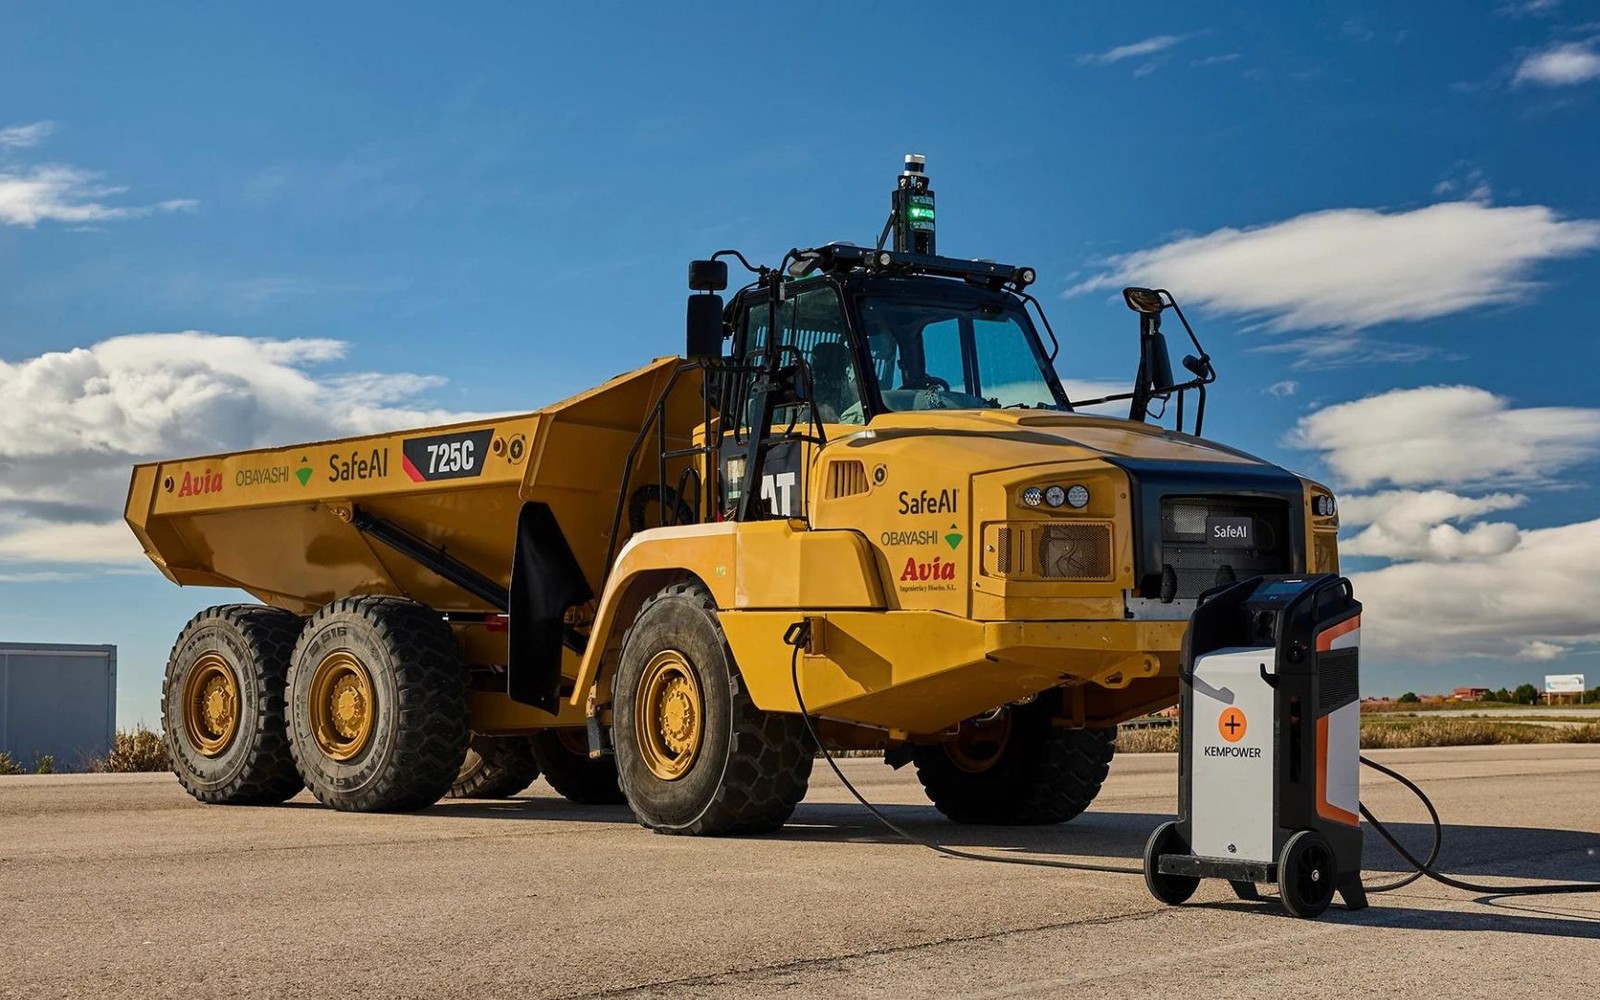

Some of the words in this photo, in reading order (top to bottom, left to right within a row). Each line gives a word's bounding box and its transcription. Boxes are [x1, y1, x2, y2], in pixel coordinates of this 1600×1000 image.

[328, 447, 388, 483] SafeAI
[427, 439, 475, 474] 725C
[178, 468, 223, 498] Avia
[235, 465, 290, 487] OBAYASHI
[761, 471, 796, 517] AT
[898, 488, 957, 515] SafeAI
[880, 530, 939, 546] OBAYASHI
[1214, 525, 1247, 538] SafeAI
[900, 556, 956, 581] Avia
[1204, 746, 1262, 758] KEMPOWER
